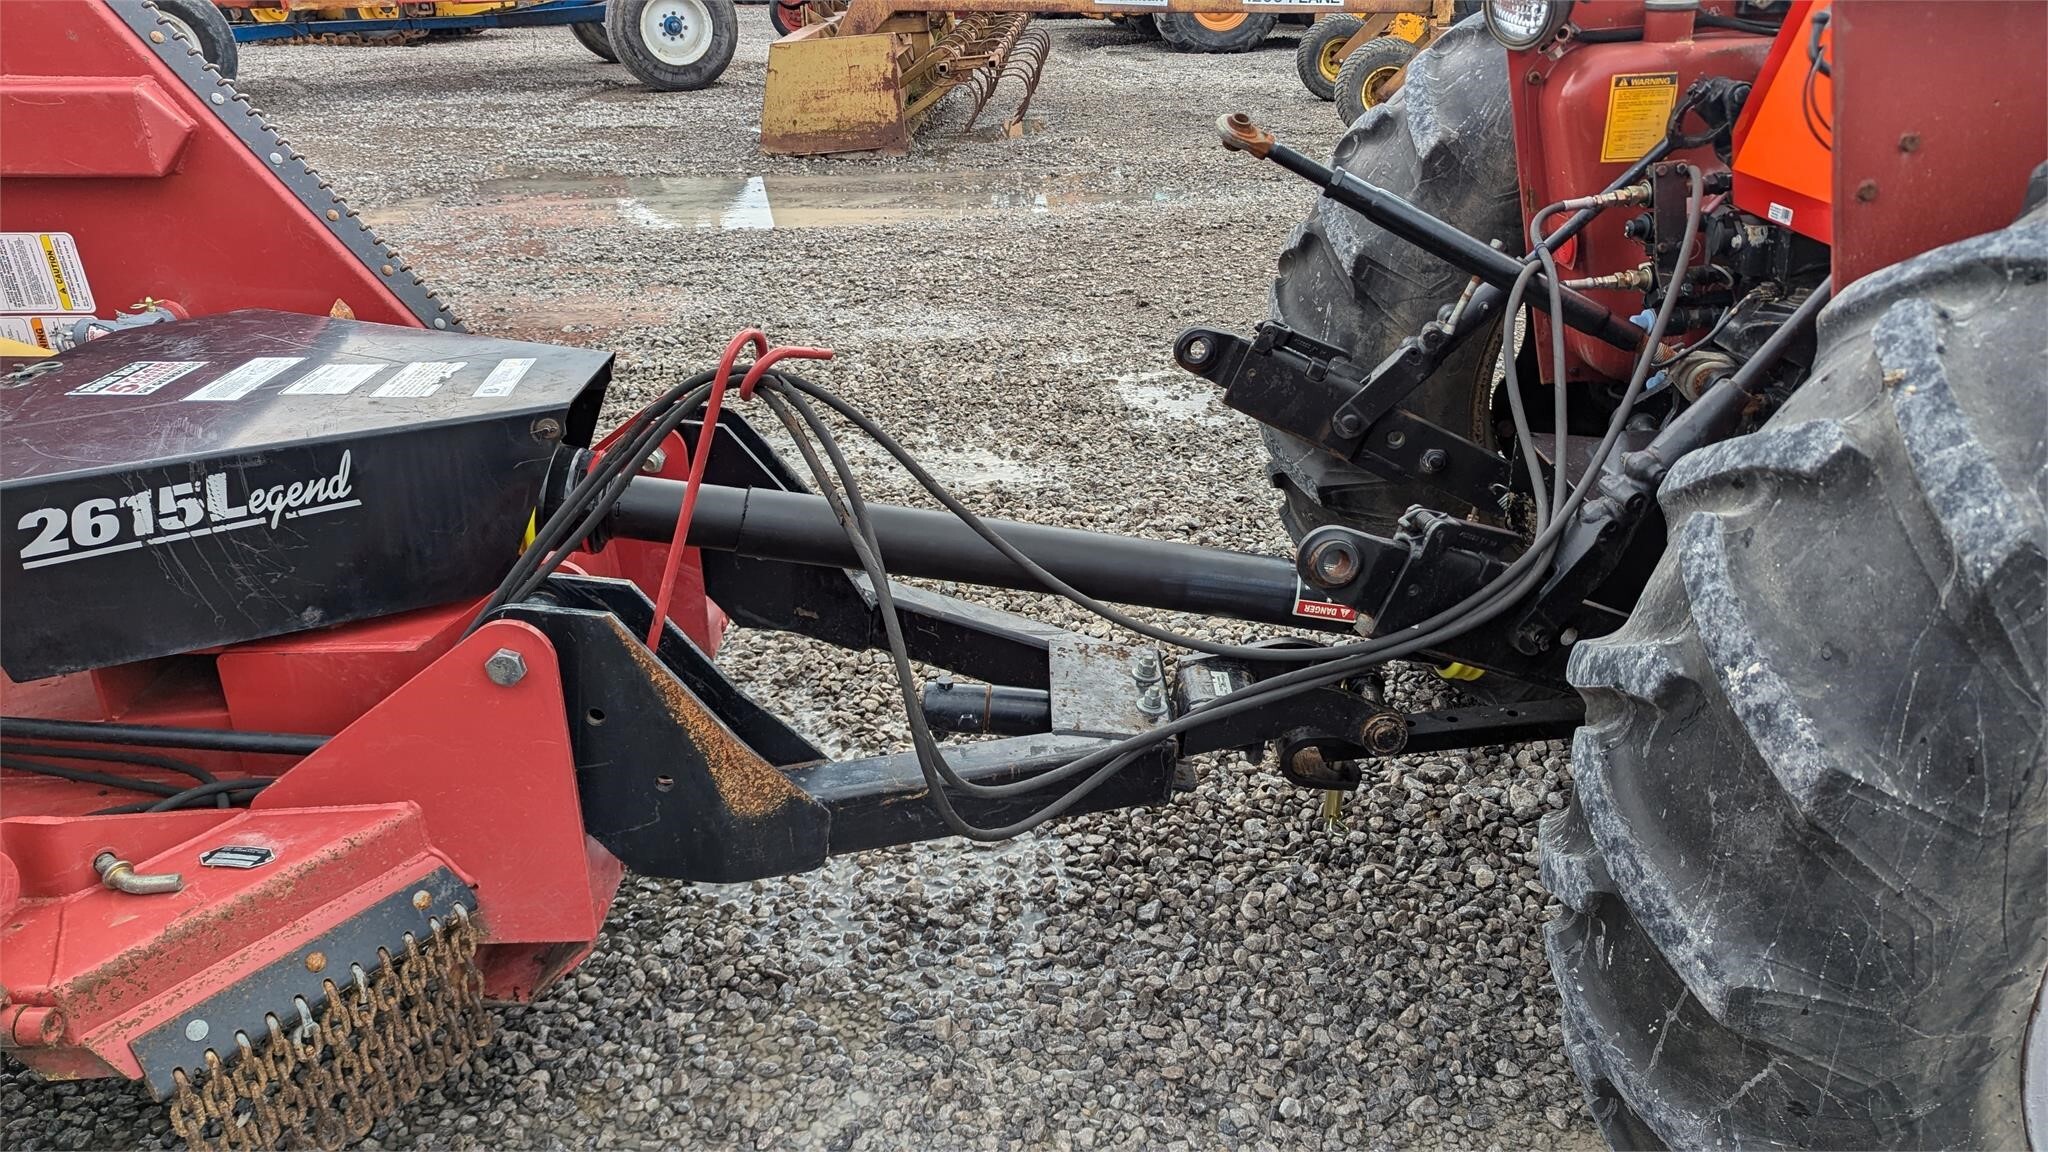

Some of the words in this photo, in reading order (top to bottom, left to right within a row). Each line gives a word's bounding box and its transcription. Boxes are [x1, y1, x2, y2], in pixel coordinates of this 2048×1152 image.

[1631, 77, 1671, 86] WARNING
[46, 250, 63, 284] CAUTION
[36, 328, 50, 349] NING
[1303, 604, 1337, 616] DANGER
